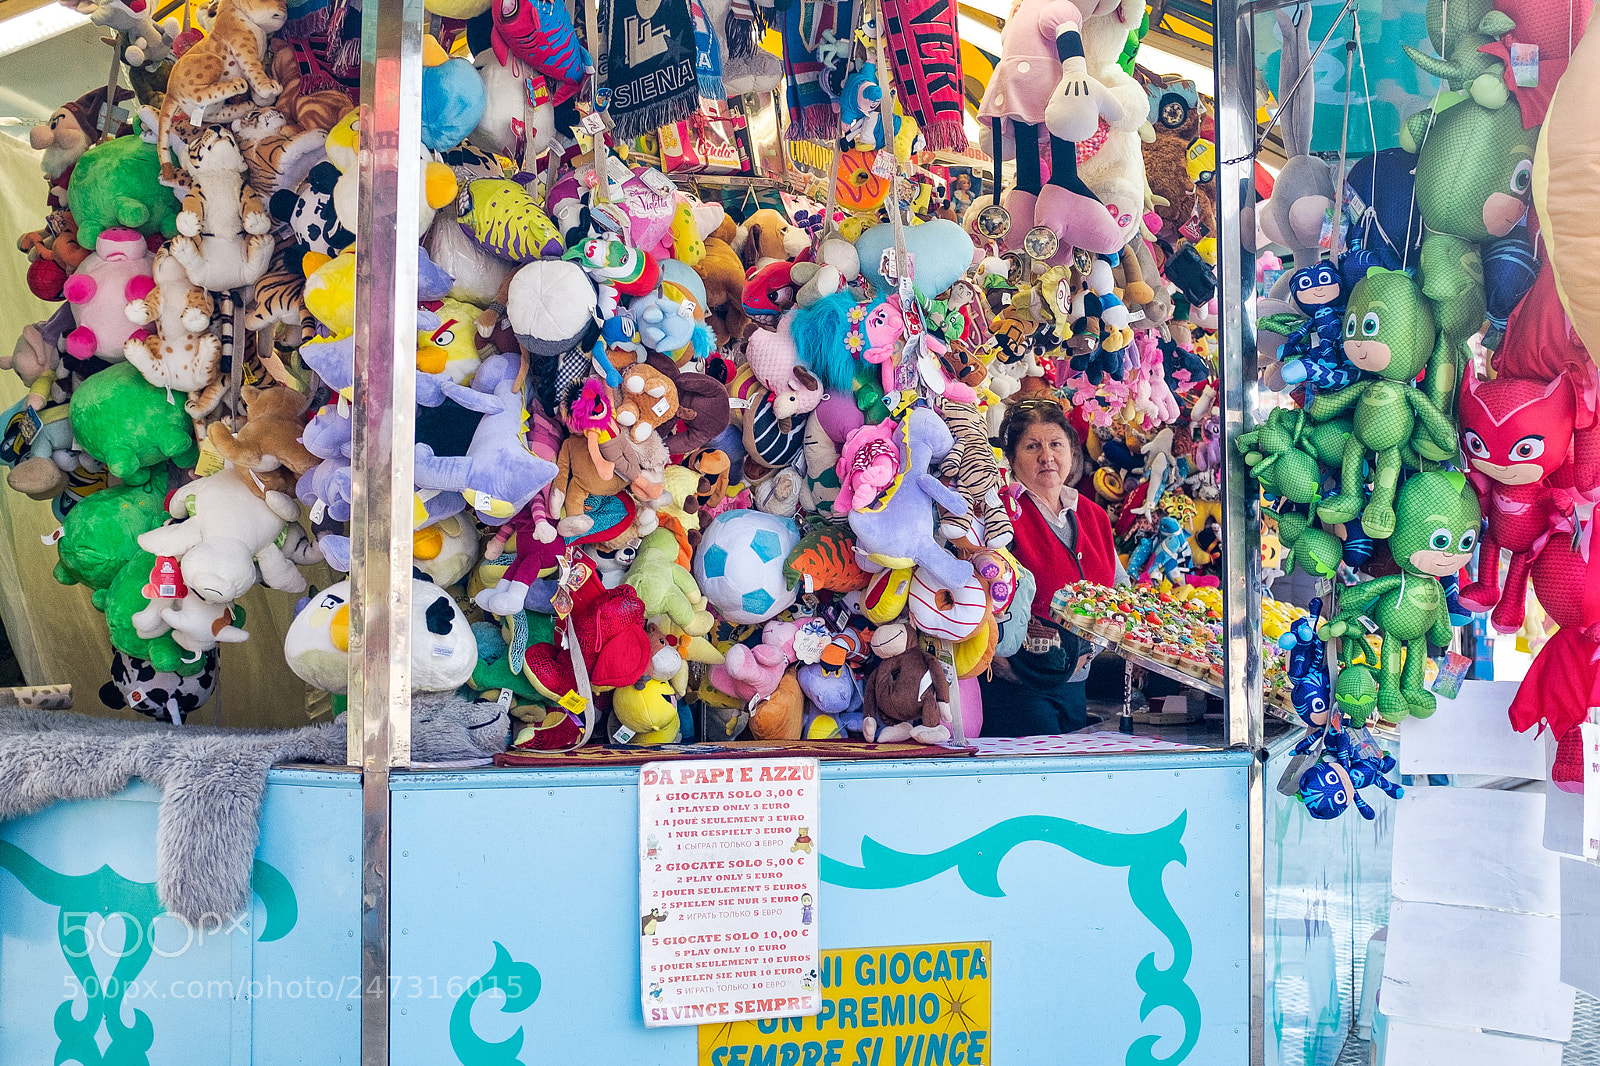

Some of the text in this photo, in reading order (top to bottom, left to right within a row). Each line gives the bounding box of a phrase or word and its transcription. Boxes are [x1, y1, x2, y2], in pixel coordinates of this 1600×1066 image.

[614, 58, 695, 108] SIENA
[643, 770, 674, 785] DA
[680, 768, 733, 784] PAPI
[759, 766, 814, 781] AZZU
[666, 792, 724, 800] GIOCATA
[766, 789, 792, 798] 3,00
[701, 816, 764, 824] SEULEMENT
[666, 861, 724, 871] GIOCATE
[729, 860, 762, 868] SOLO
[767, 858, 793, 867] 5,00
[662, 889, 695, 898] JOUER
[698, 886, 761, 894] SEULEMENT
[670, 900, 715, 908] SPIELEN
[719, 910, 750, 918] ТОЛЬКО
[663, 935, 721, 945] GIOCATE
[725, 932, 759, 941] SOLO
[764, 930, 797, 939] 10,00
[660, 963, 692, 972] JOUER
[696, 958, 758, 968] SEULEMENT
[855, 948, 987, 985] GIOCATA
[668, 974, 713, 983] SPIELEN
[652, 997, 813, 1020] SI VINCE SEMPRE
[816, 992, 941, 1031] PREMIO
[711, 1031, 987, 1066] SEMPRE SI VINCE
